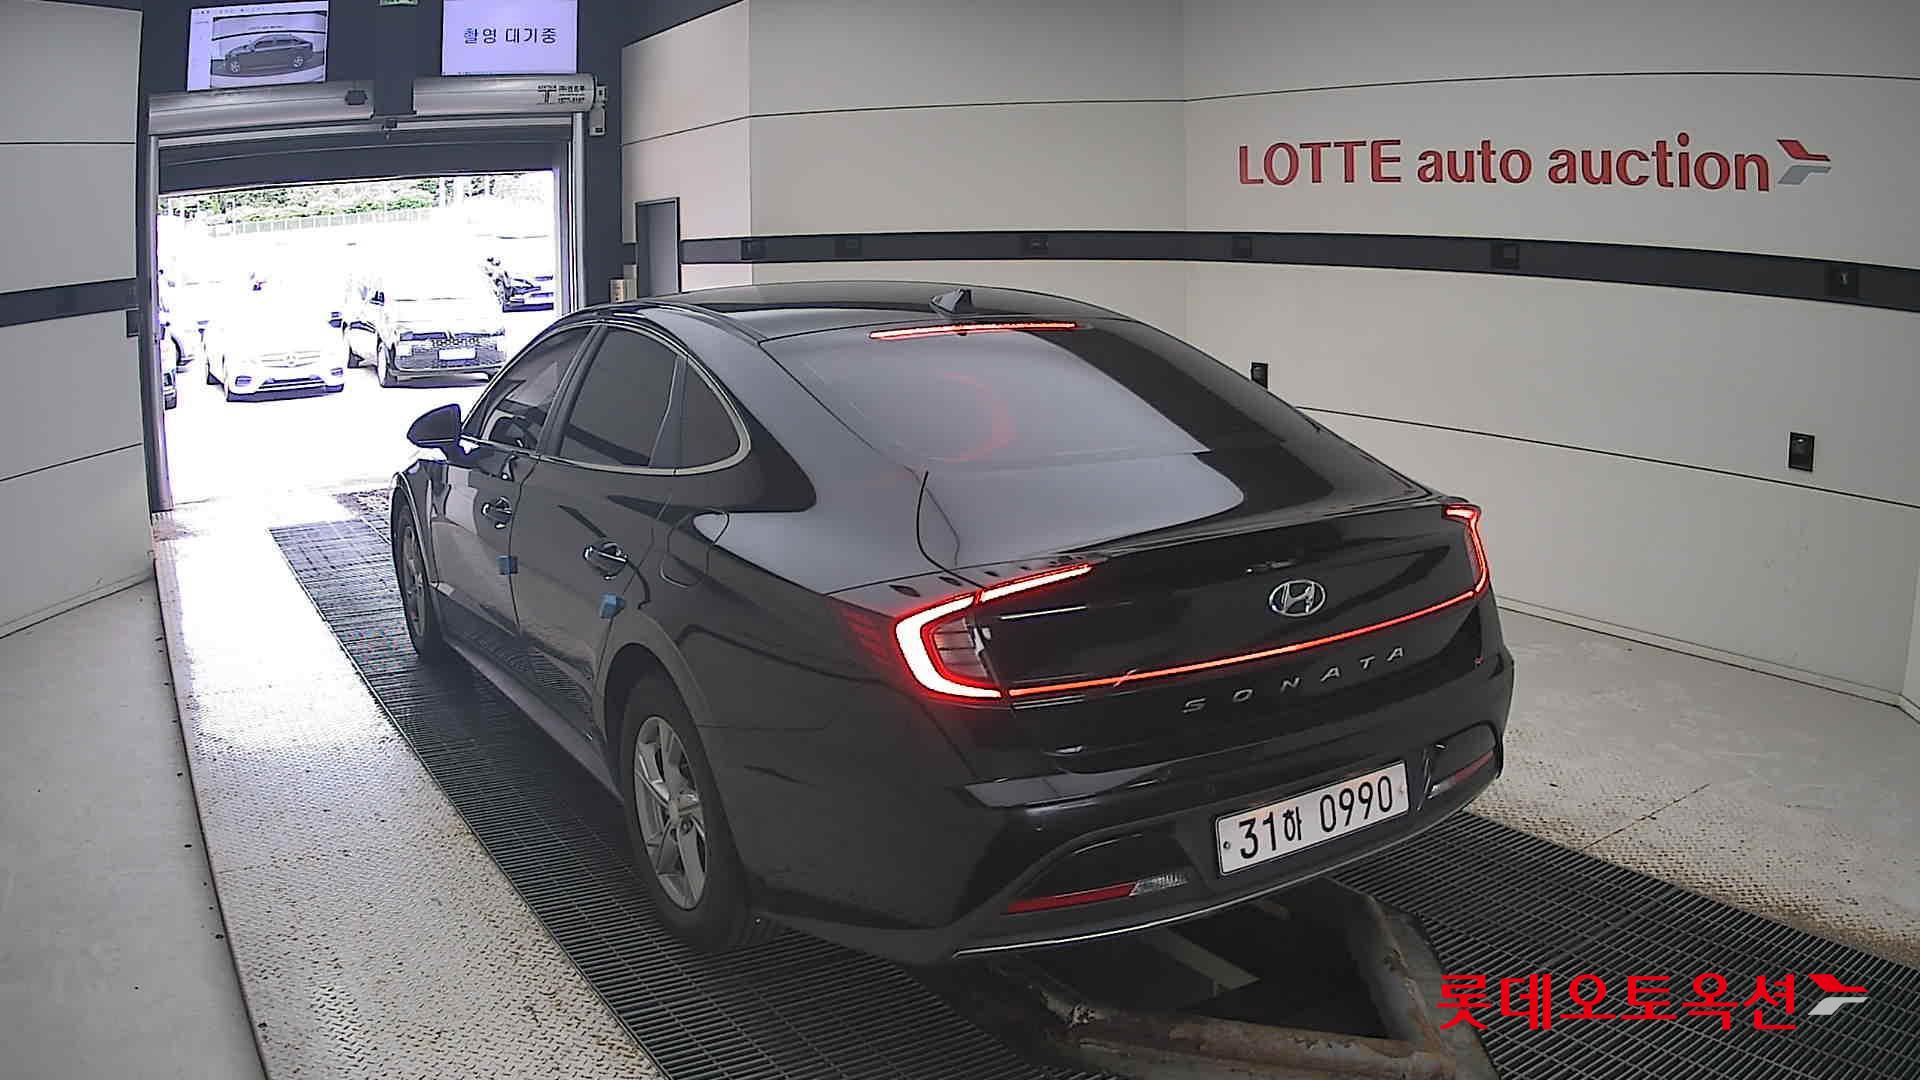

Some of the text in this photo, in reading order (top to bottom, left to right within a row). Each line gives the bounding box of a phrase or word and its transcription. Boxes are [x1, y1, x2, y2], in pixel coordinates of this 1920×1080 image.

[504, 27, 557, 45] 대기중
[1238, 132, 1771, 192] LOTTE auto auction
[1182, 646, 1405, 713] SONATA
[1239, 775, 1394, 860] 31하 0990
